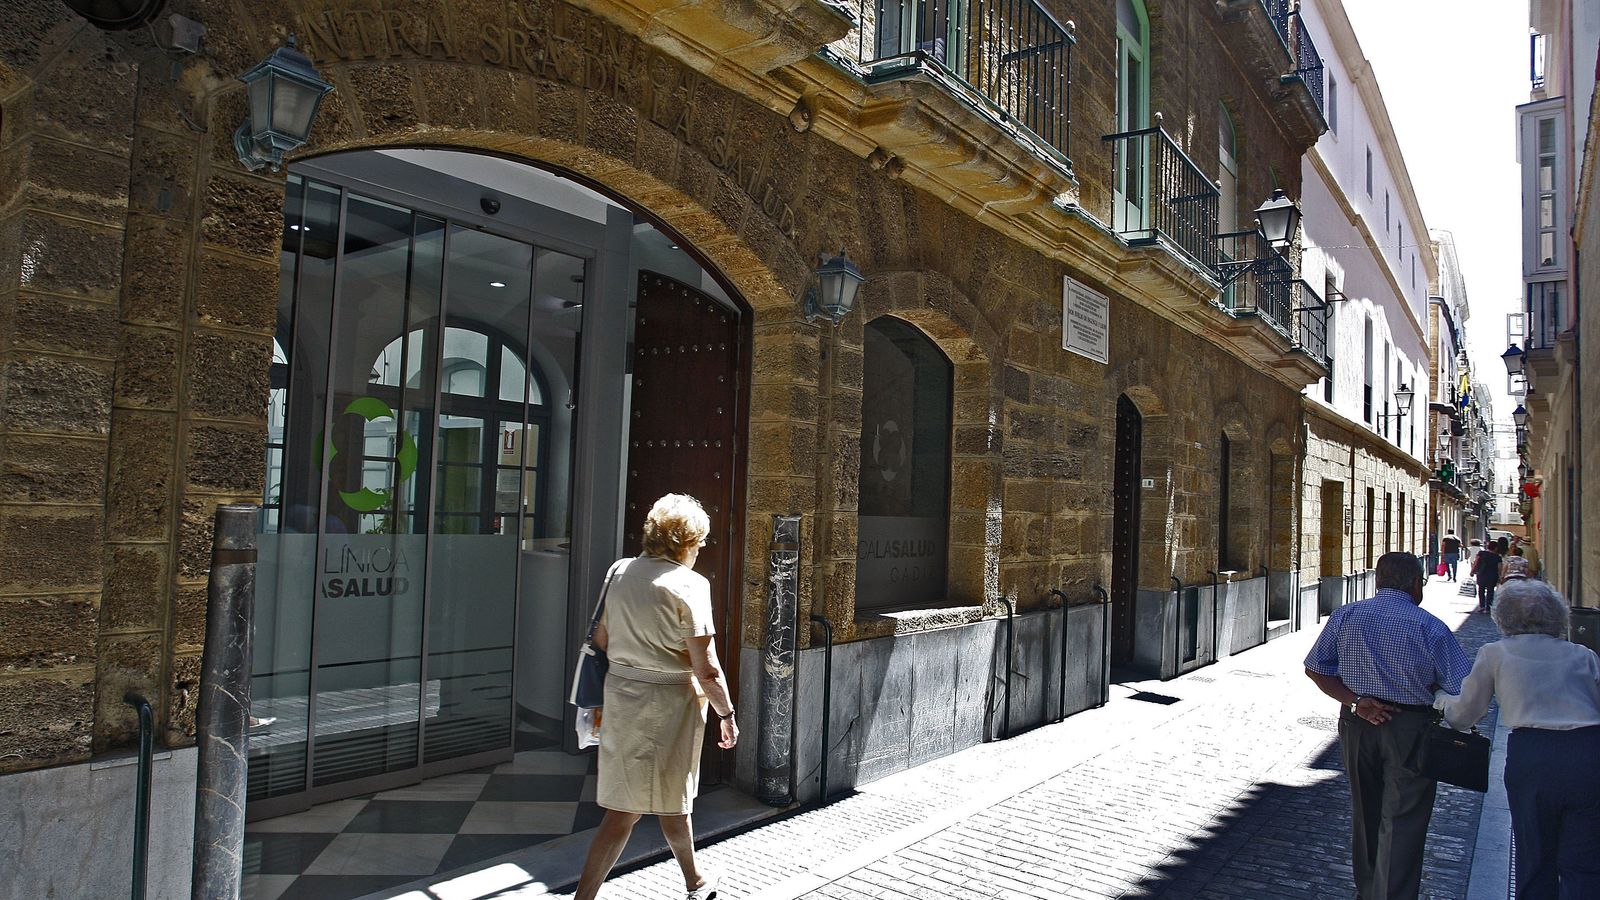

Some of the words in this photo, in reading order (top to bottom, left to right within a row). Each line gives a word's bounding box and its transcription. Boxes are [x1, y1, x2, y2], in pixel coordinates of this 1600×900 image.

[299, 8, 457, 63] NTRA
[480, 21, 566, 81] SRA
[648, 87, 696, 145] LA
[702, 135, 796, 239] SALUD
[324, 543, 410, 574] LÍNICA
